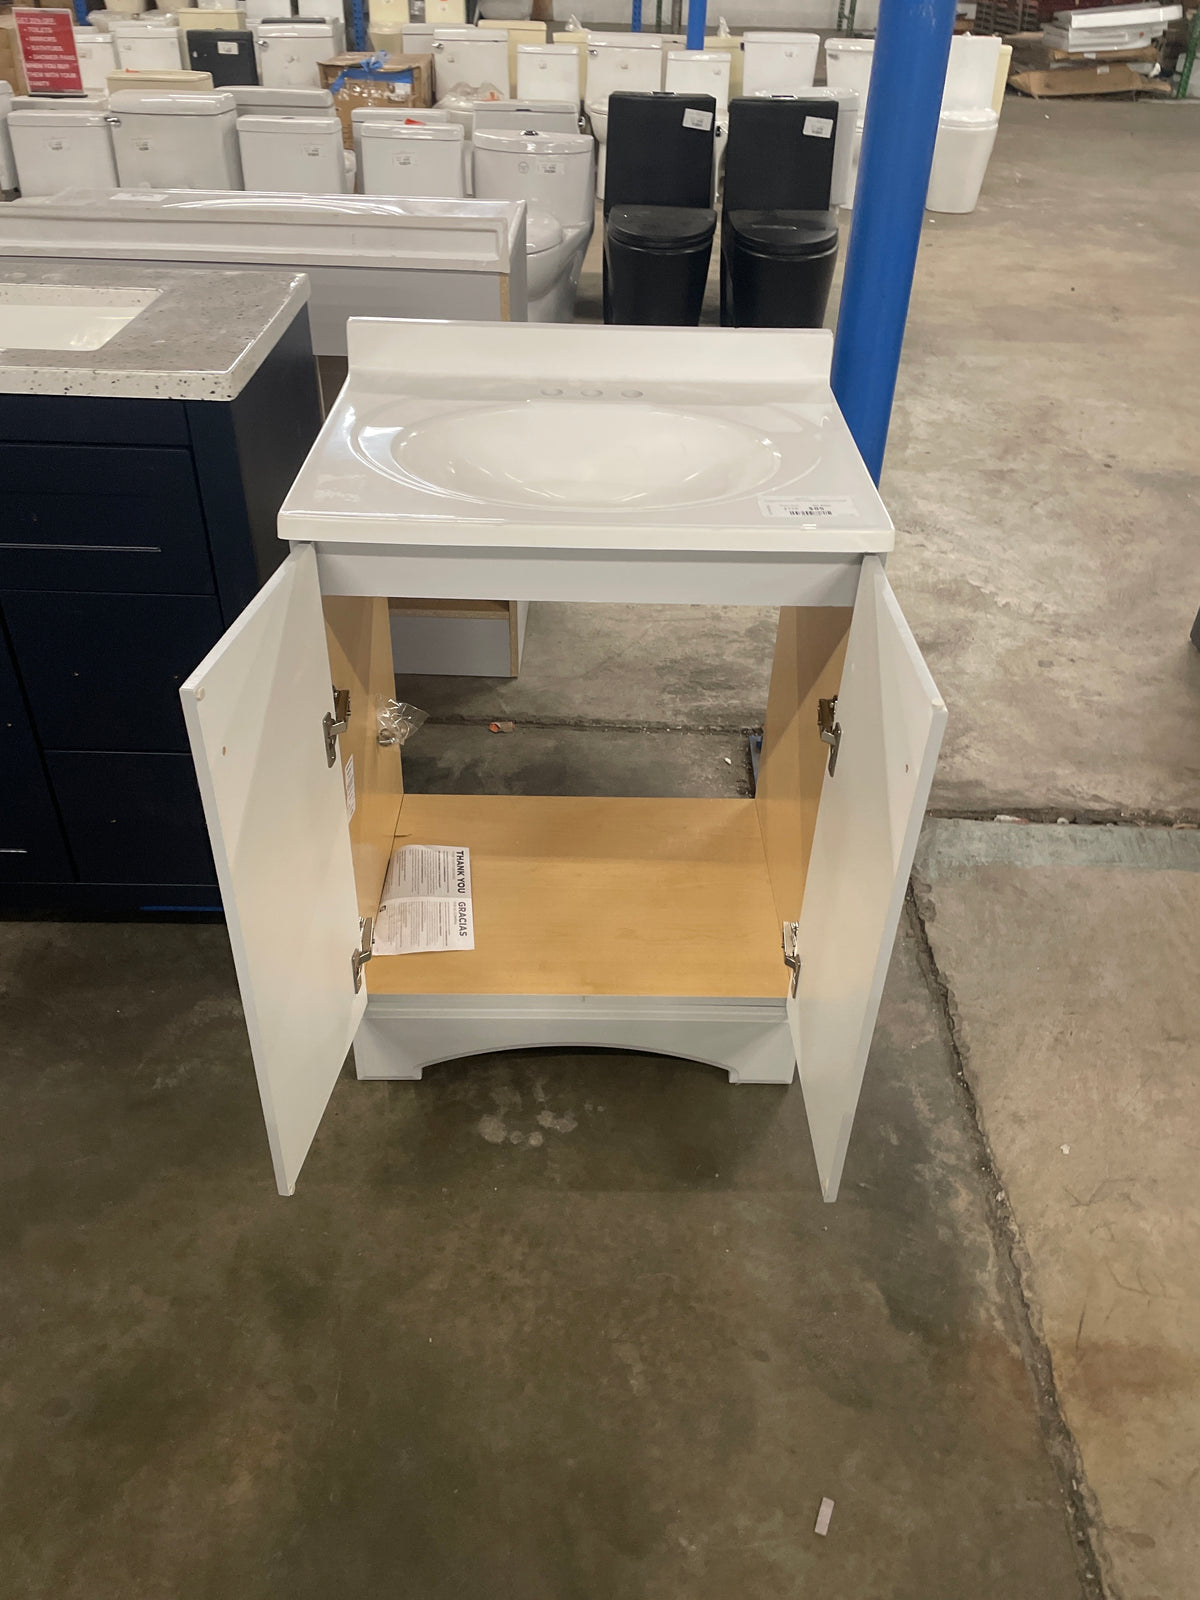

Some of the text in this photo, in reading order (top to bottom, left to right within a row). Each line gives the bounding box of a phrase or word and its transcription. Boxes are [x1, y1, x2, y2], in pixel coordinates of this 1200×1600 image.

[456, 850, 466, 894] THANK YOU
[458, 901, 468, 937] GRACIAS
